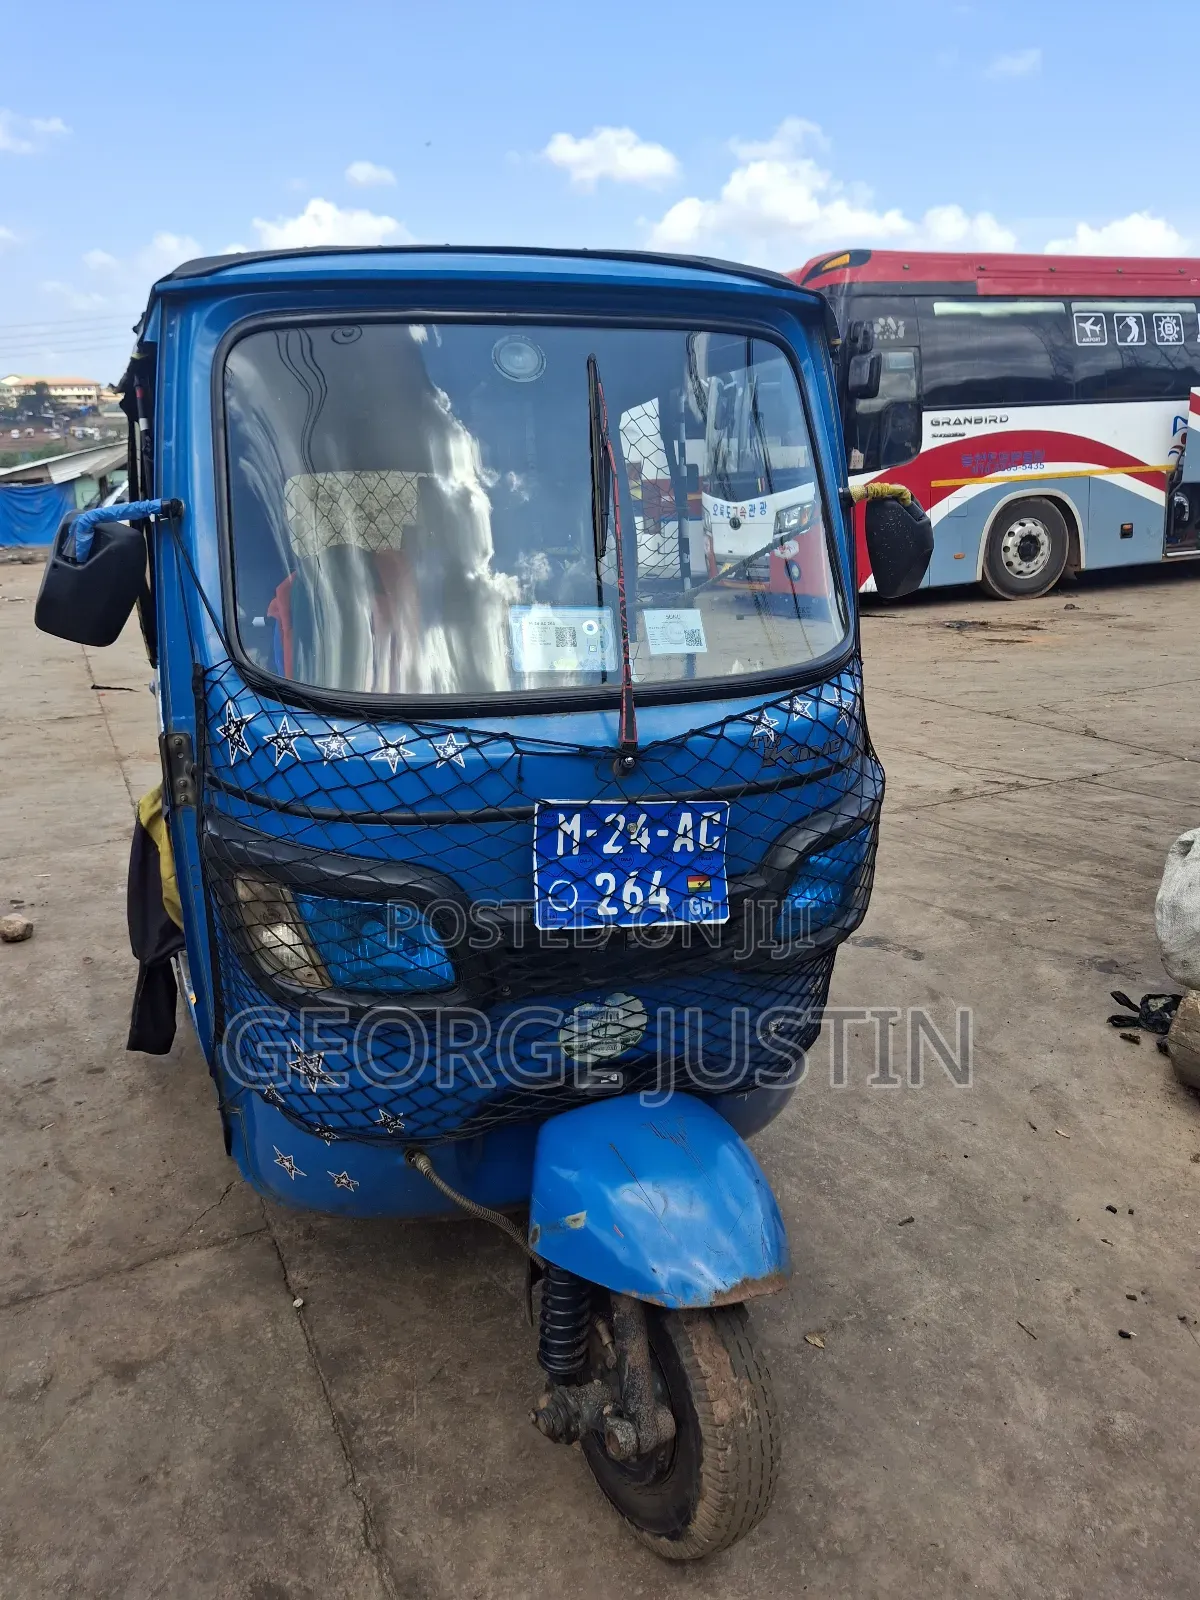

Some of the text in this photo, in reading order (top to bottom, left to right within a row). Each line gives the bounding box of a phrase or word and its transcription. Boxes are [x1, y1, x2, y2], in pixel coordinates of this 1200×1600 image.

[930, 414, 1009, 427] GRANBIRD
[556, 811, 721, 856] M-24-AC
[595, 871, 670, 915] 264
[688, 896, 714, 915] GH
